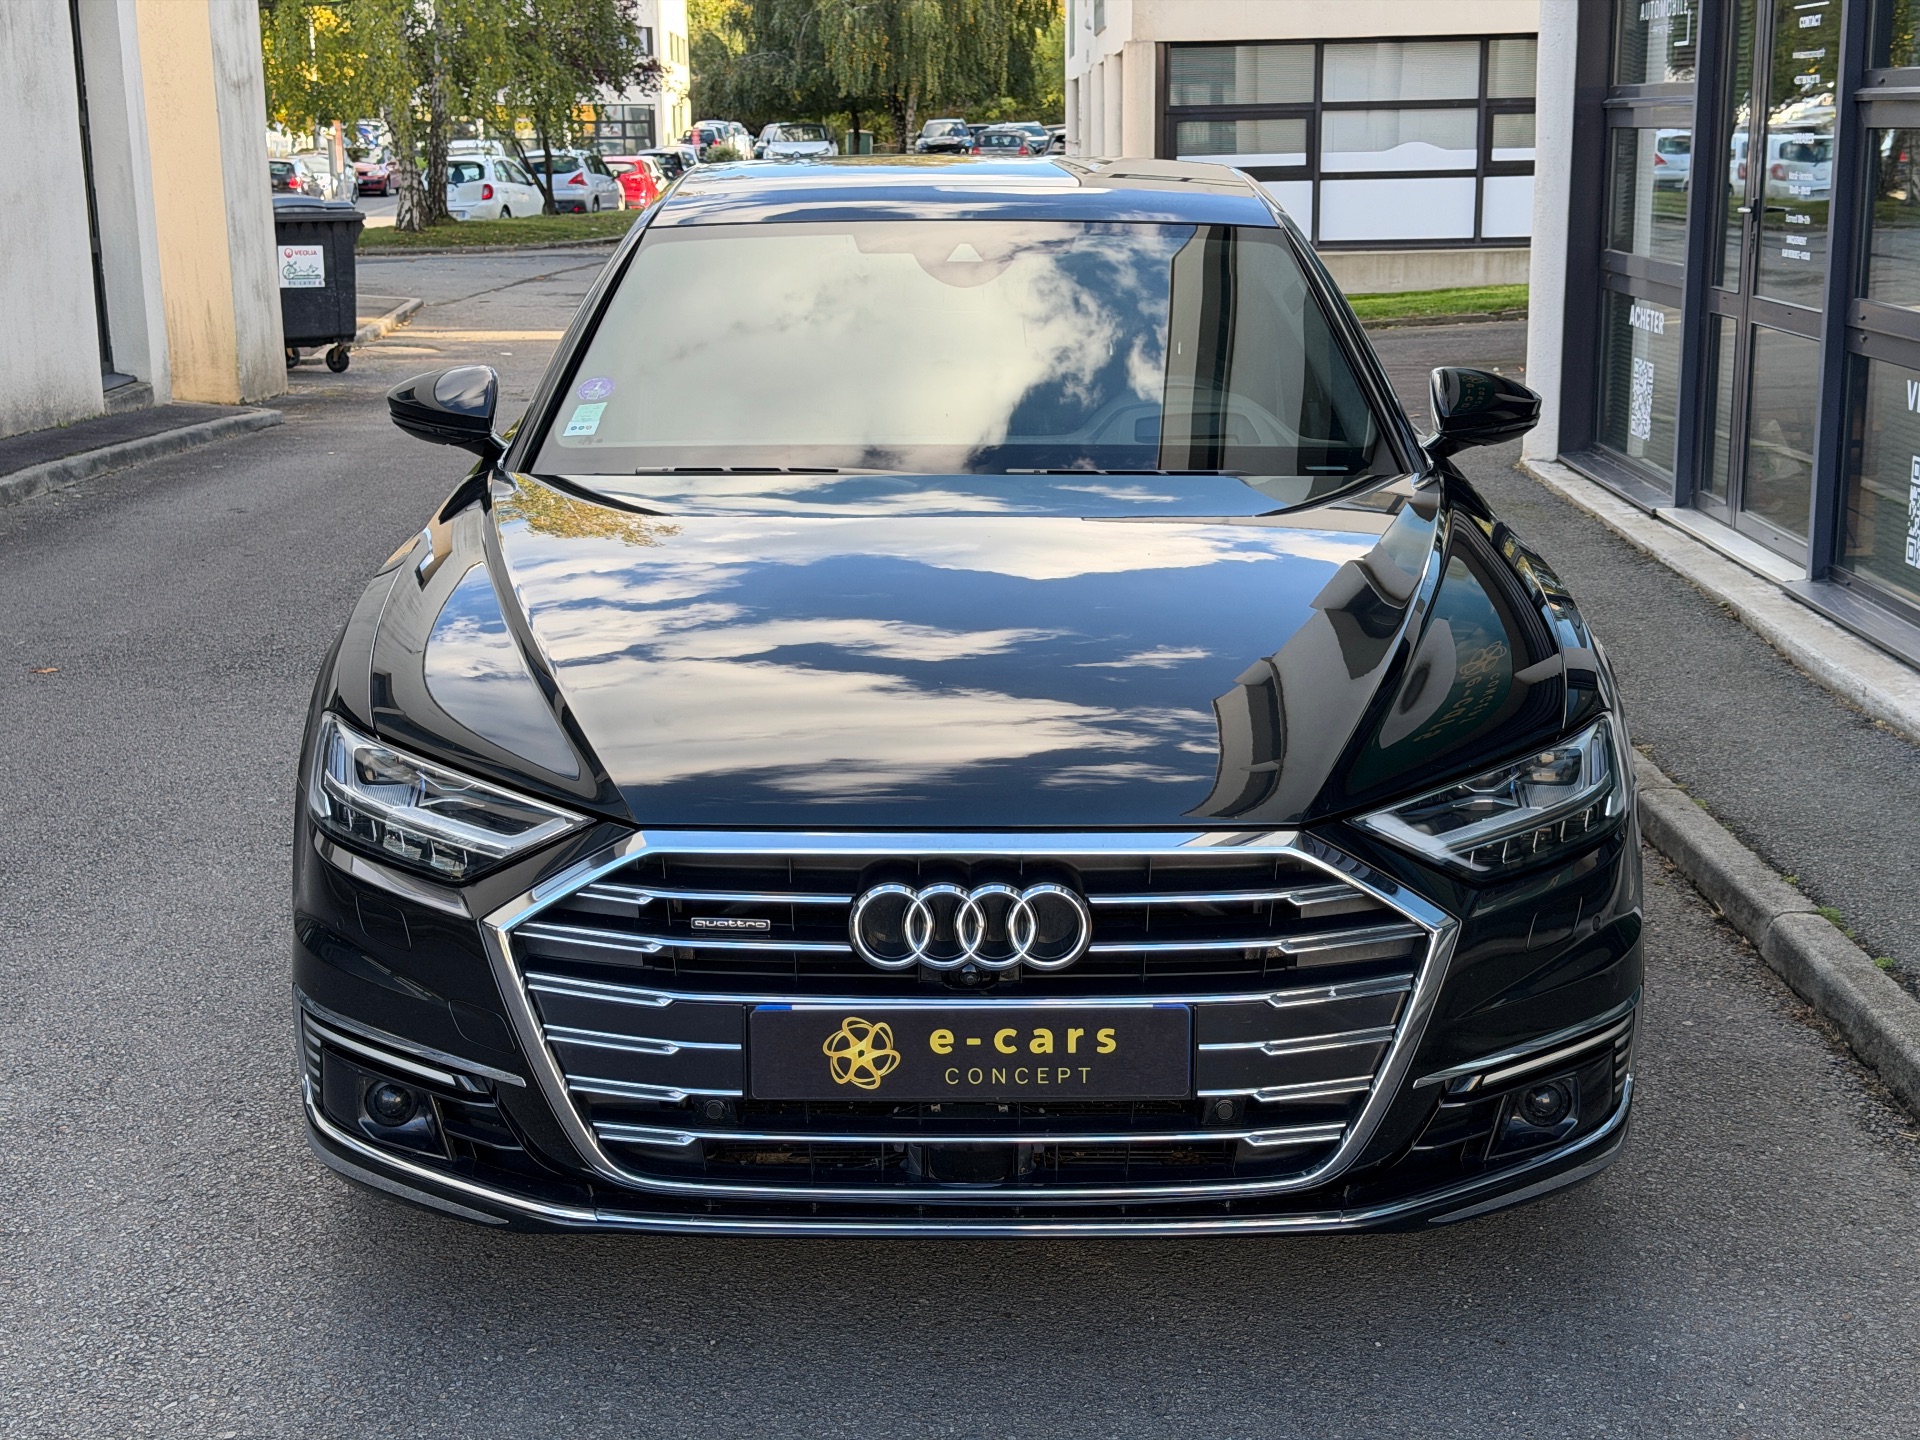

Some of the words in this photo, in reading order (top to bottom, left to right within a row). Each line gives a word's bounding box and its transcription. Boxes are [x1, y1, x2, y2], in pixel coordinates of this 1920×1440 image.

[294, 249, 318, 257] VEOLIA
[1629, 304, 1665, 335] ACHETER
[694, 919, 767, 929] quattro
[929, 1023, 1118, 1055] e-cars
[944, 1066, 1092, 1085] CONCEPT
